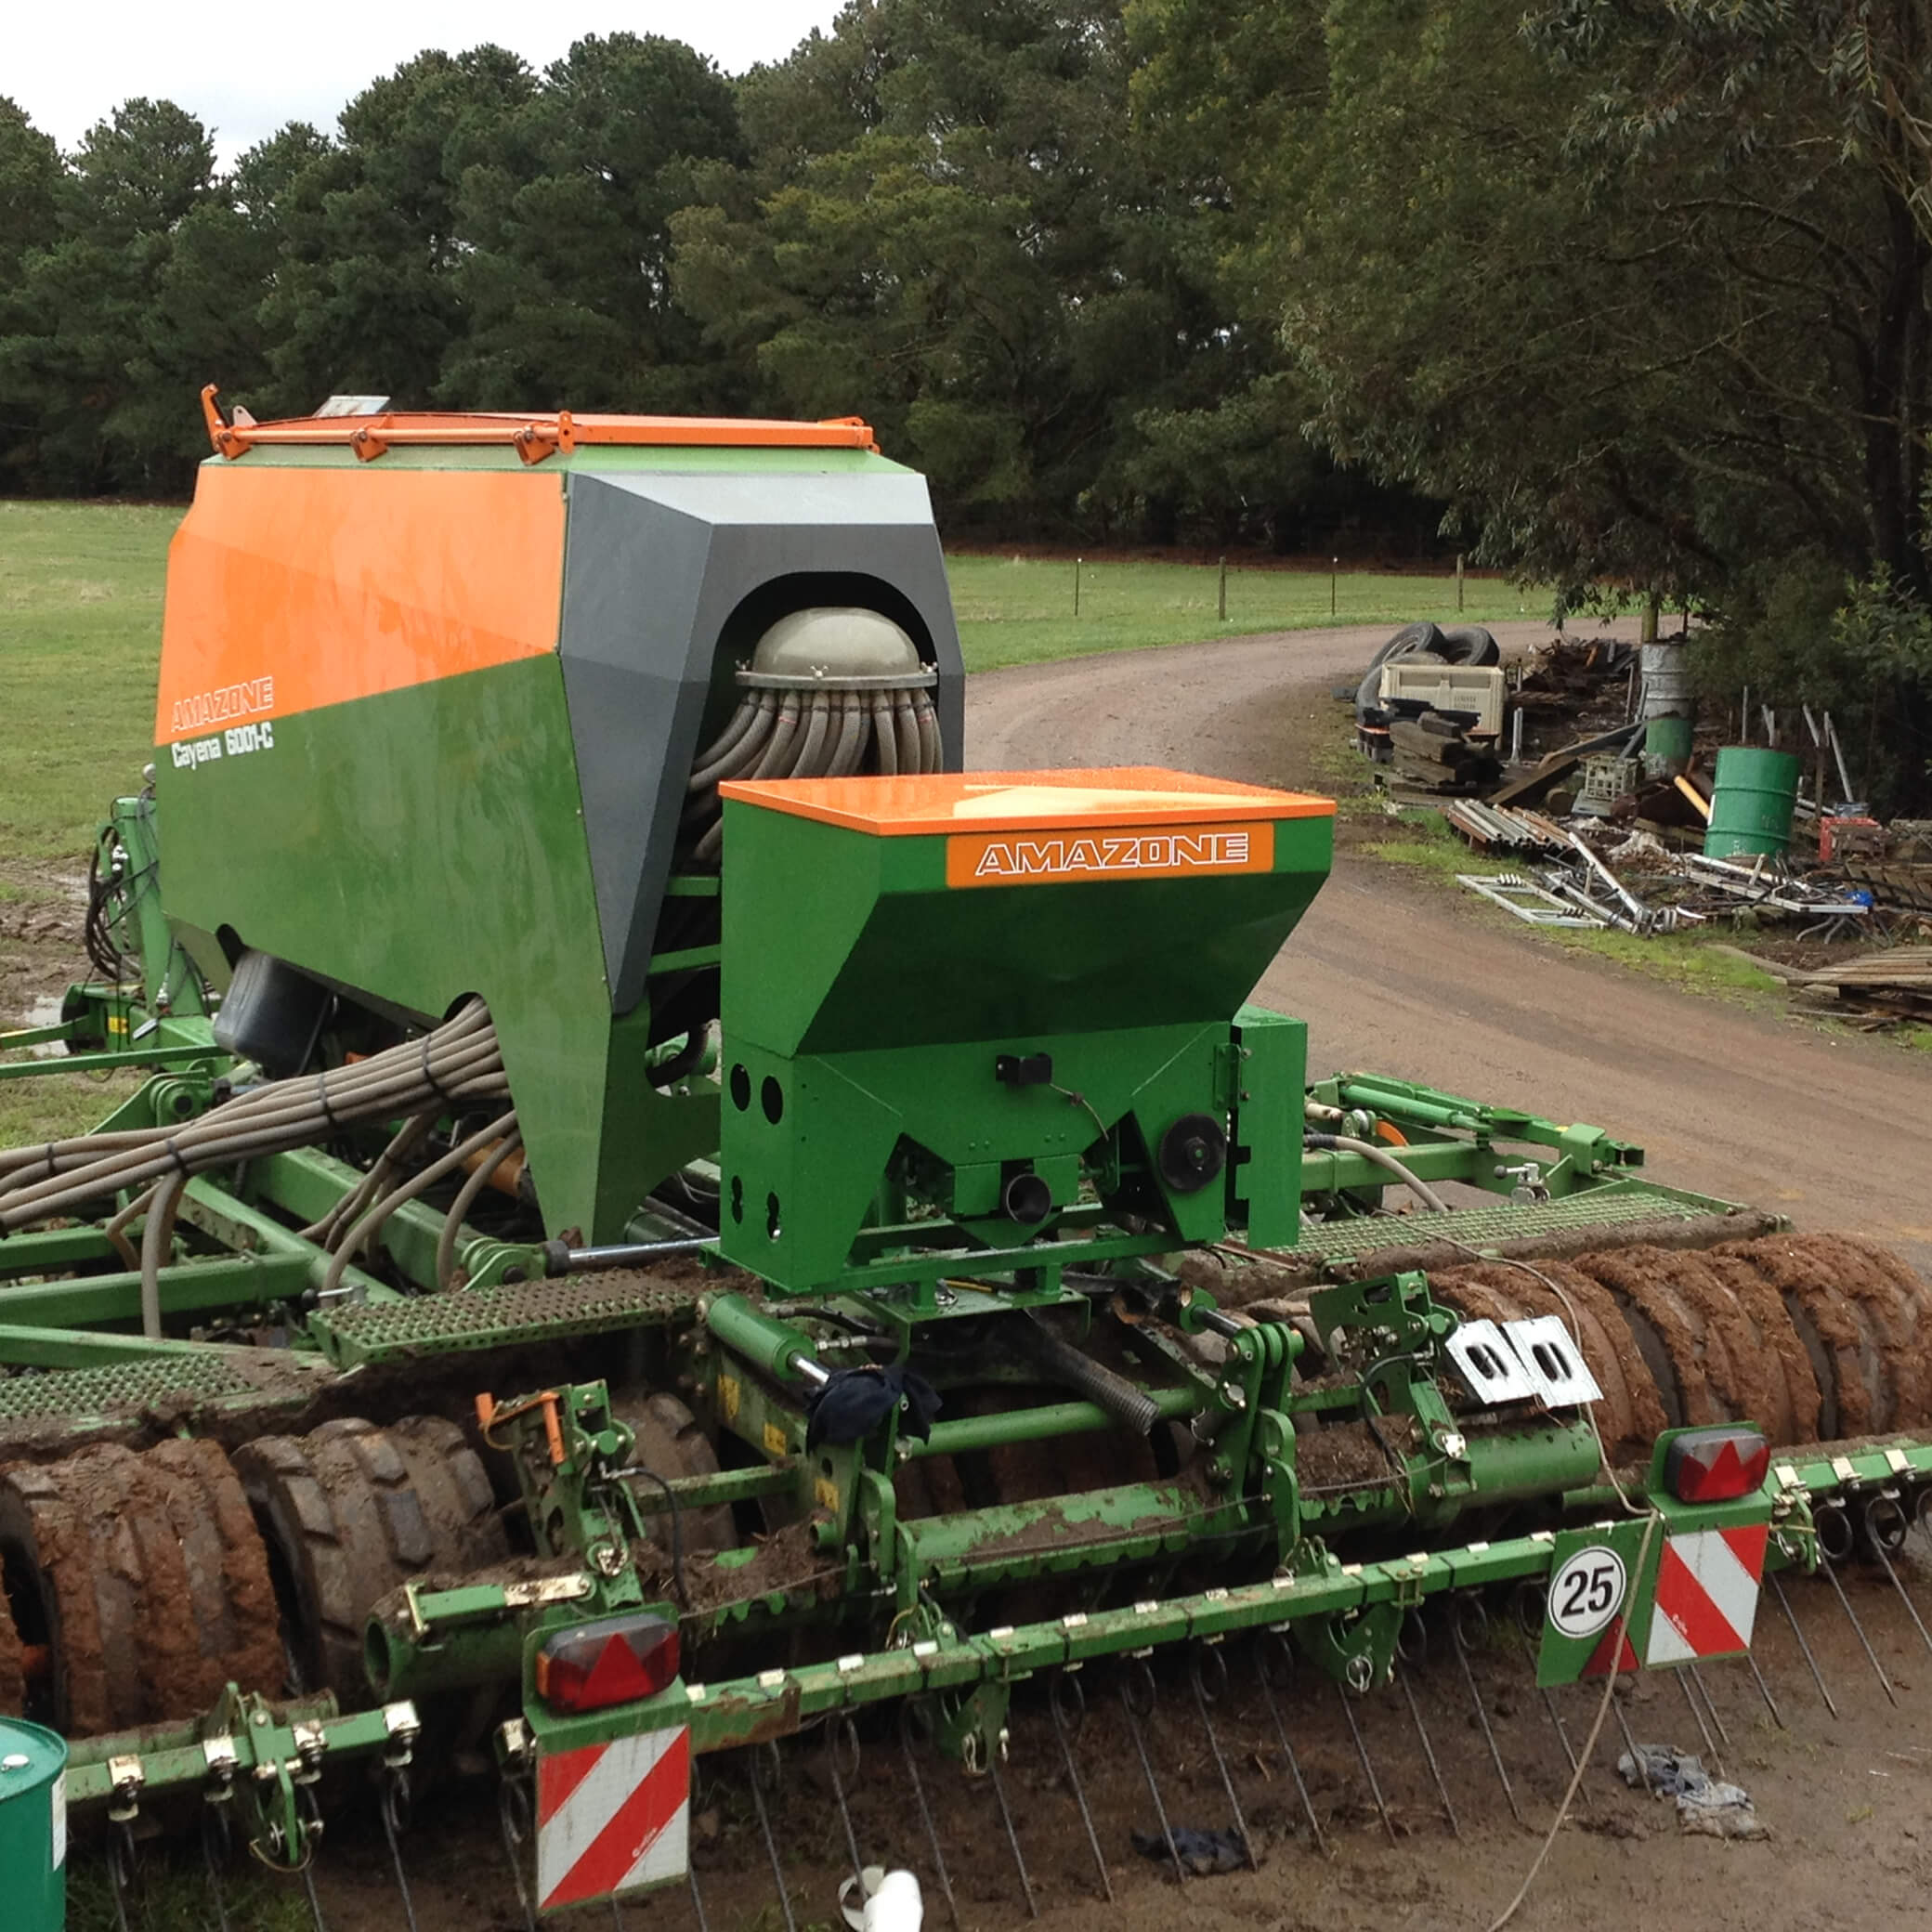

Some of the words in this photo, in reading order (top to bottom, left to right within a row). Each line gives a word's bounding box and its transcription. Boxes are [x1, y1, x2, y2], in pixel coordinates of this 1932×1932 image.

[171, 676, 273, 733] AMAZONE
[171, 738, 222, 770] Cayena
[975, 832, 1248, 876] AMAZONE
[1560, 1565, 1614, 1618] 25
